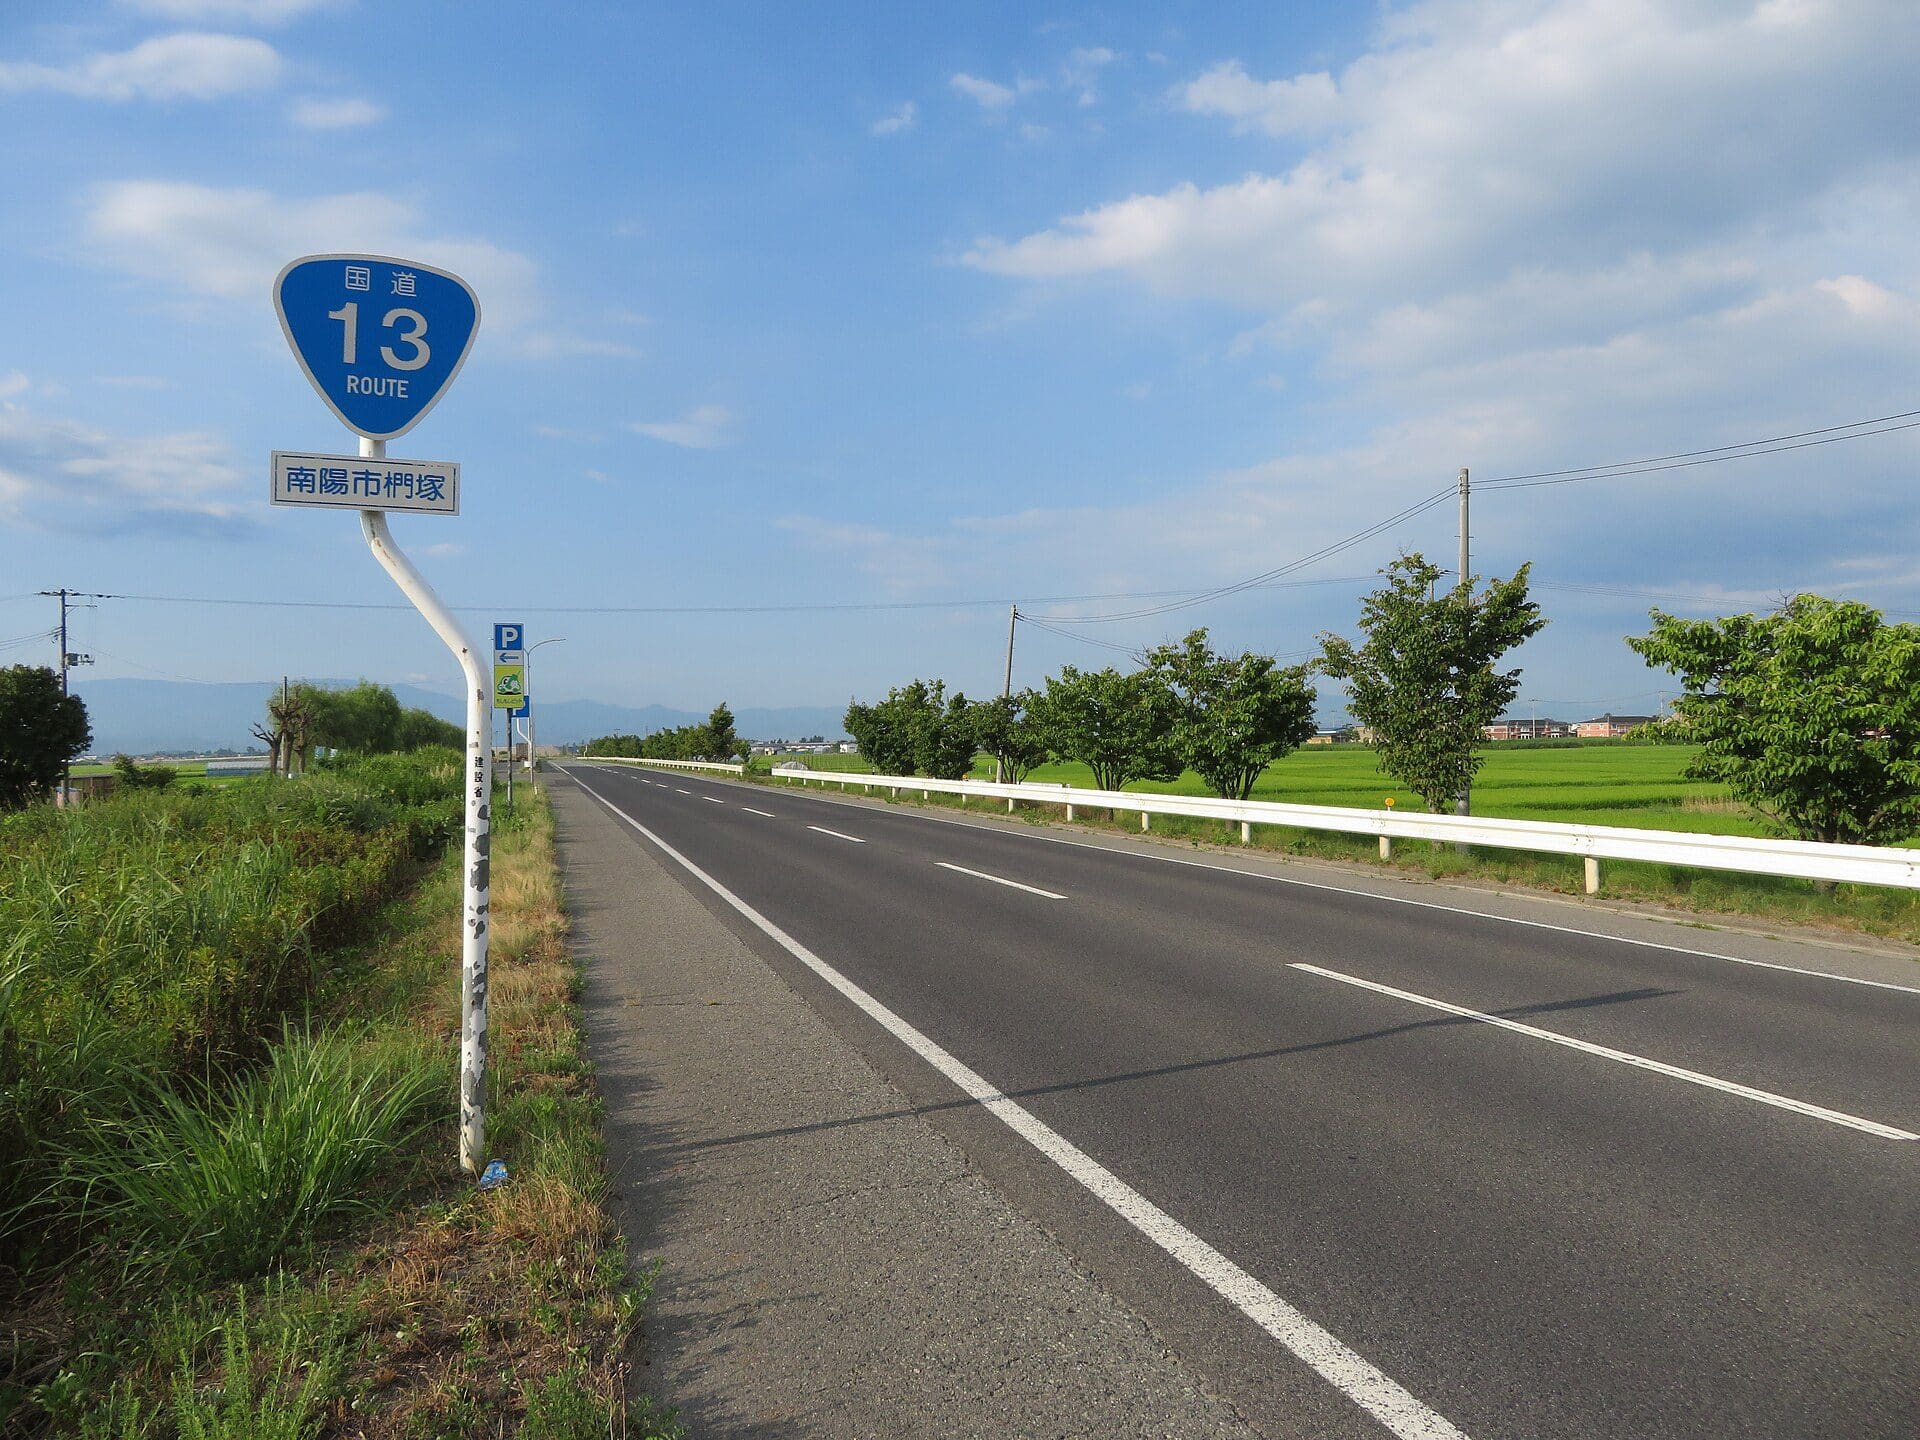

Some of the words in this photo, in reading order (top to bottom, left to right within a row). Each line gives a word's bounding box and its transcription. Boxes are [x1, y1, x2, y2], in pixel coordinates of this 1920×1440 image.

[345, 265, 417, 297] 国道
[328, 301, 431, 371] 13
[346, 374, 409, 399] ROUTE
[286, 465, 446, 501] 南陽市椚塚
[501, 626, 518, 649] P
[474, 756, 484, 798] 建設省
